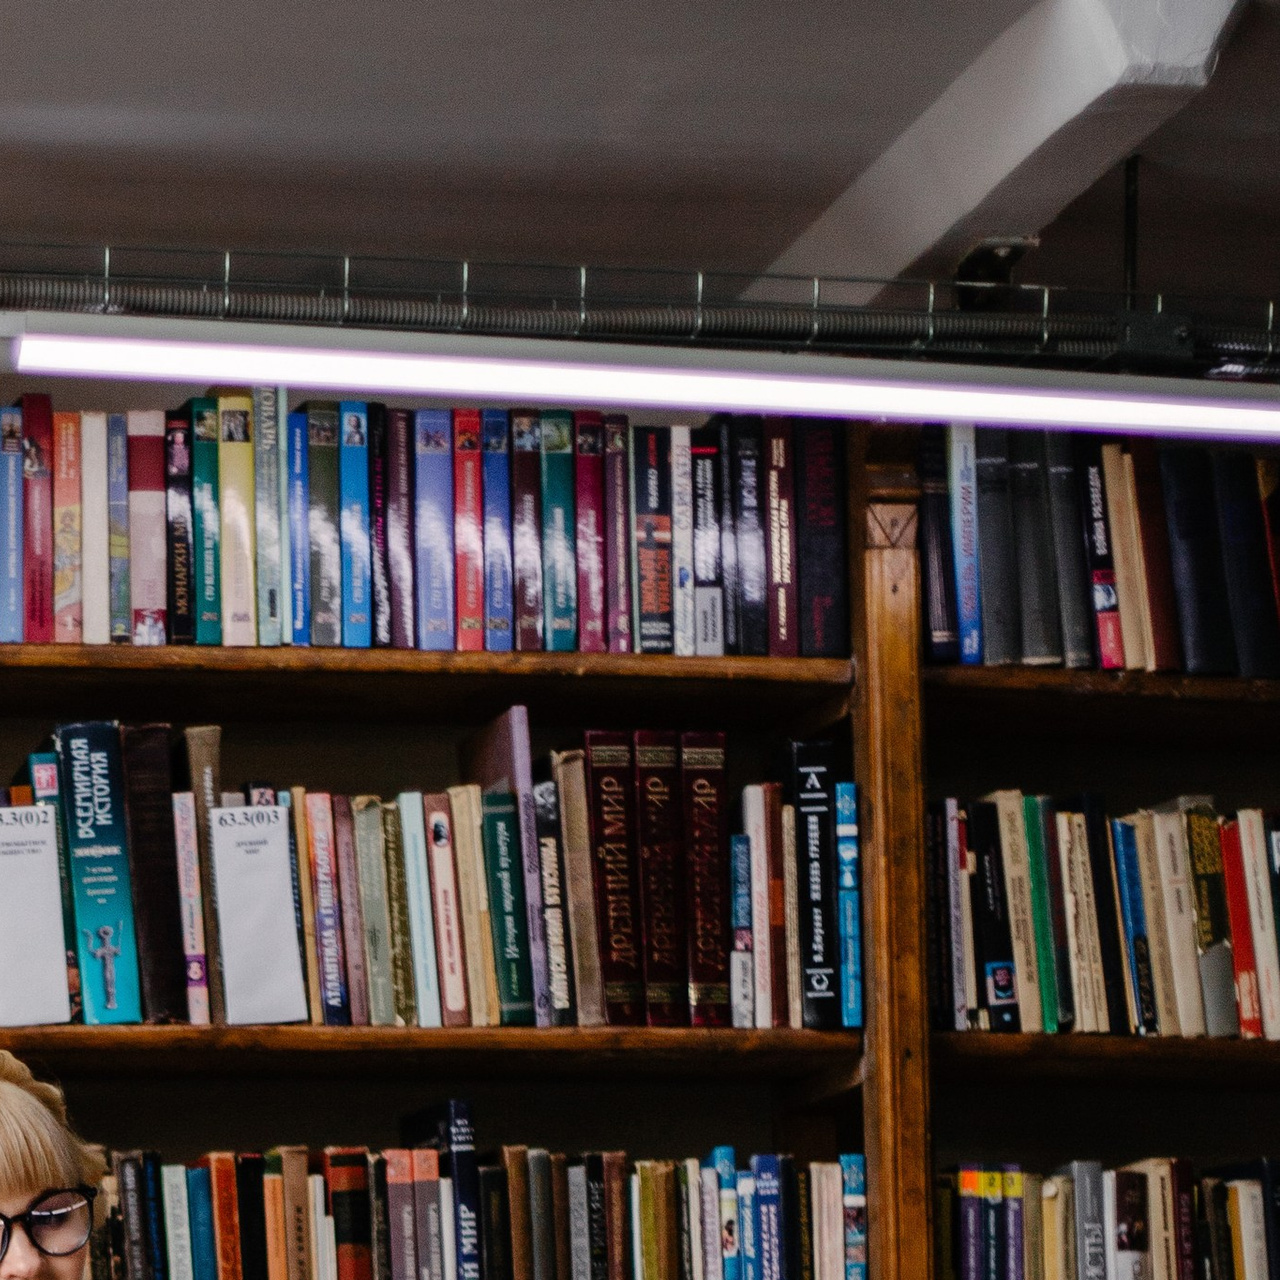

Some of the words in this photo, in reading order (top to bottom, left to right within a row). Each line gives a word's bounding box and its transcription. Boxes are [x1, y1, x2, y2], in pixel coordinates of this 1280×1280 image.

[174, 543, 188, 615] МОНАРХИ
[70, 737, 96, 839] ВСЕМИРНАЯ
[92, 752, 113, 826] ИСТОРИЯ
[218, 808, 280, 828] 63.3(0)3
[600, 776, 626, 836] МИР
[314, 830, 336, 915] ГИПЕРБОРЕЯ
[541, 837, 561, 905] РИМСКАЯ
[596, 842, 638, 968] ДРЕВНИЙ
[321, 929, 344, 1008] АТЛАНТИДА
[548, 908, 570, 1010] ЦИВИЛИЗАЦИЯ
[458, 1204, 479, 1255] МИР
